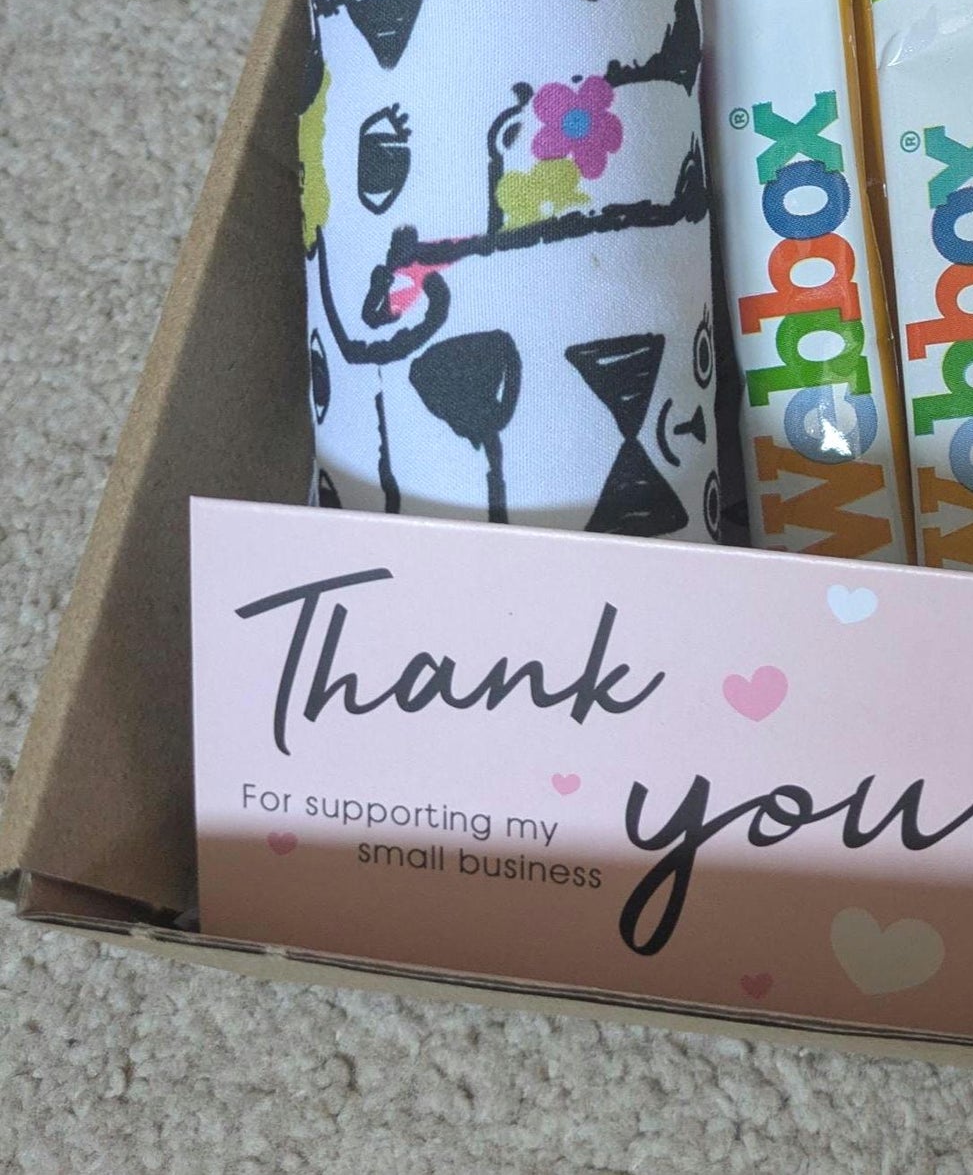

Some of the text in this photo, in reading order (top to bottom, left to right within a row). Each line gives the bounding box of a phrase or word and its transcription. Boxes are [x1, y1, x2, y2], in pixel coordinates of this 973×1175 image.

[235, 567, 666, 756] Thank
[242, 783, 559, 845] For supporting my
[358, 840, 603, 890] small business
